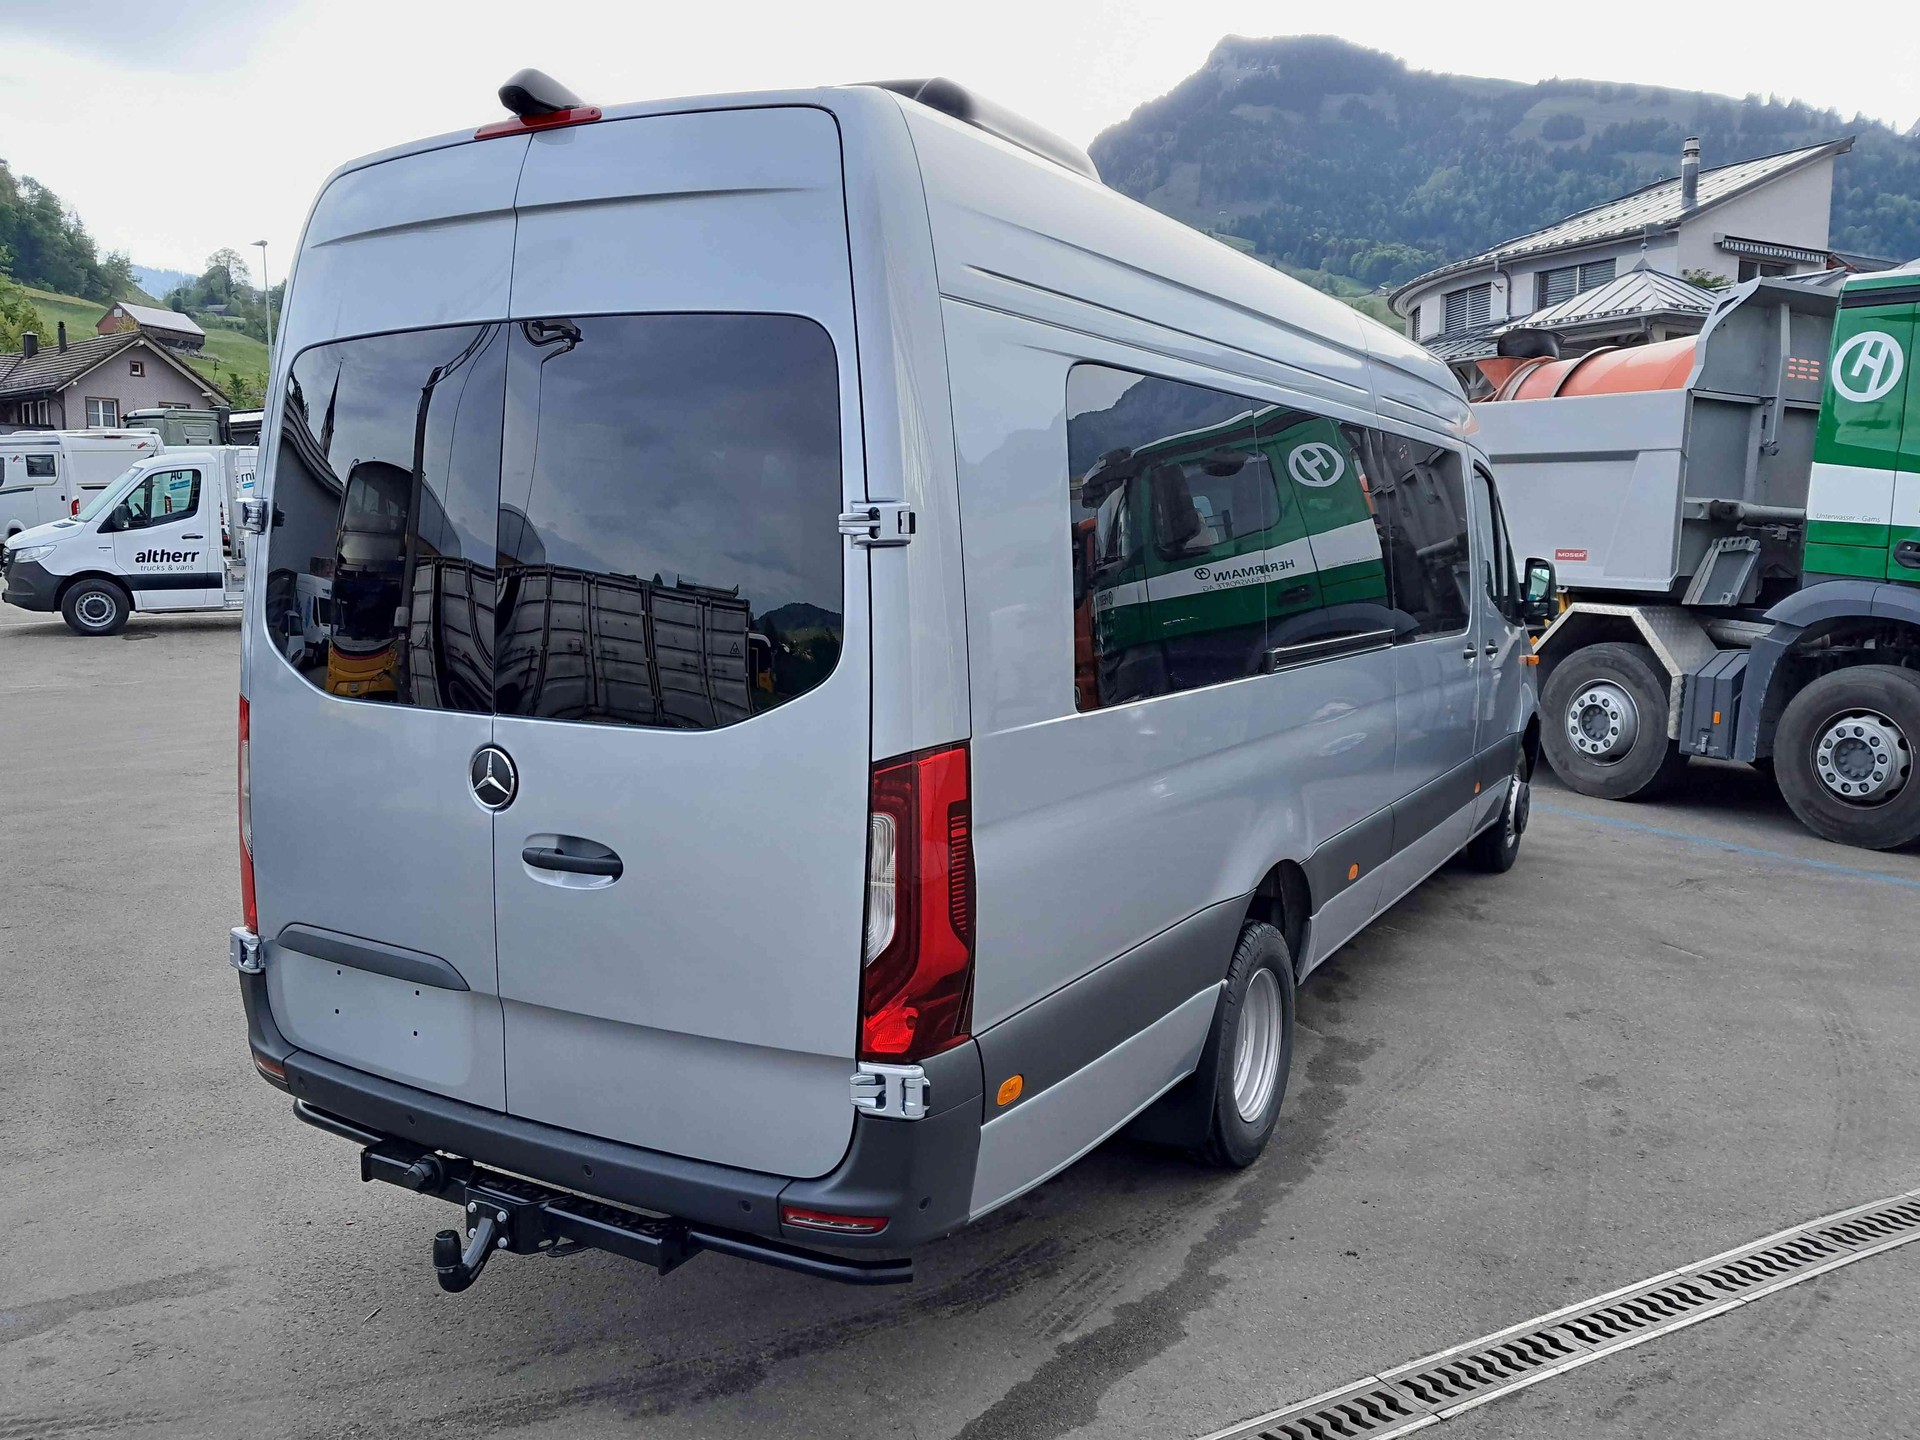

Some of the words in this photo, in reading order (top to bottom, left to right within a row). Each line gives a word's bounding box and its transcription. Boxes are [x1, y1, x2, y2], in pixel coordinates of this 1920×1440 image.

[1816, 513, 1855, 521] Unterwasser
[1862, 515, 1881, 523] Gams
[135, 549, 200, 563] altherr
